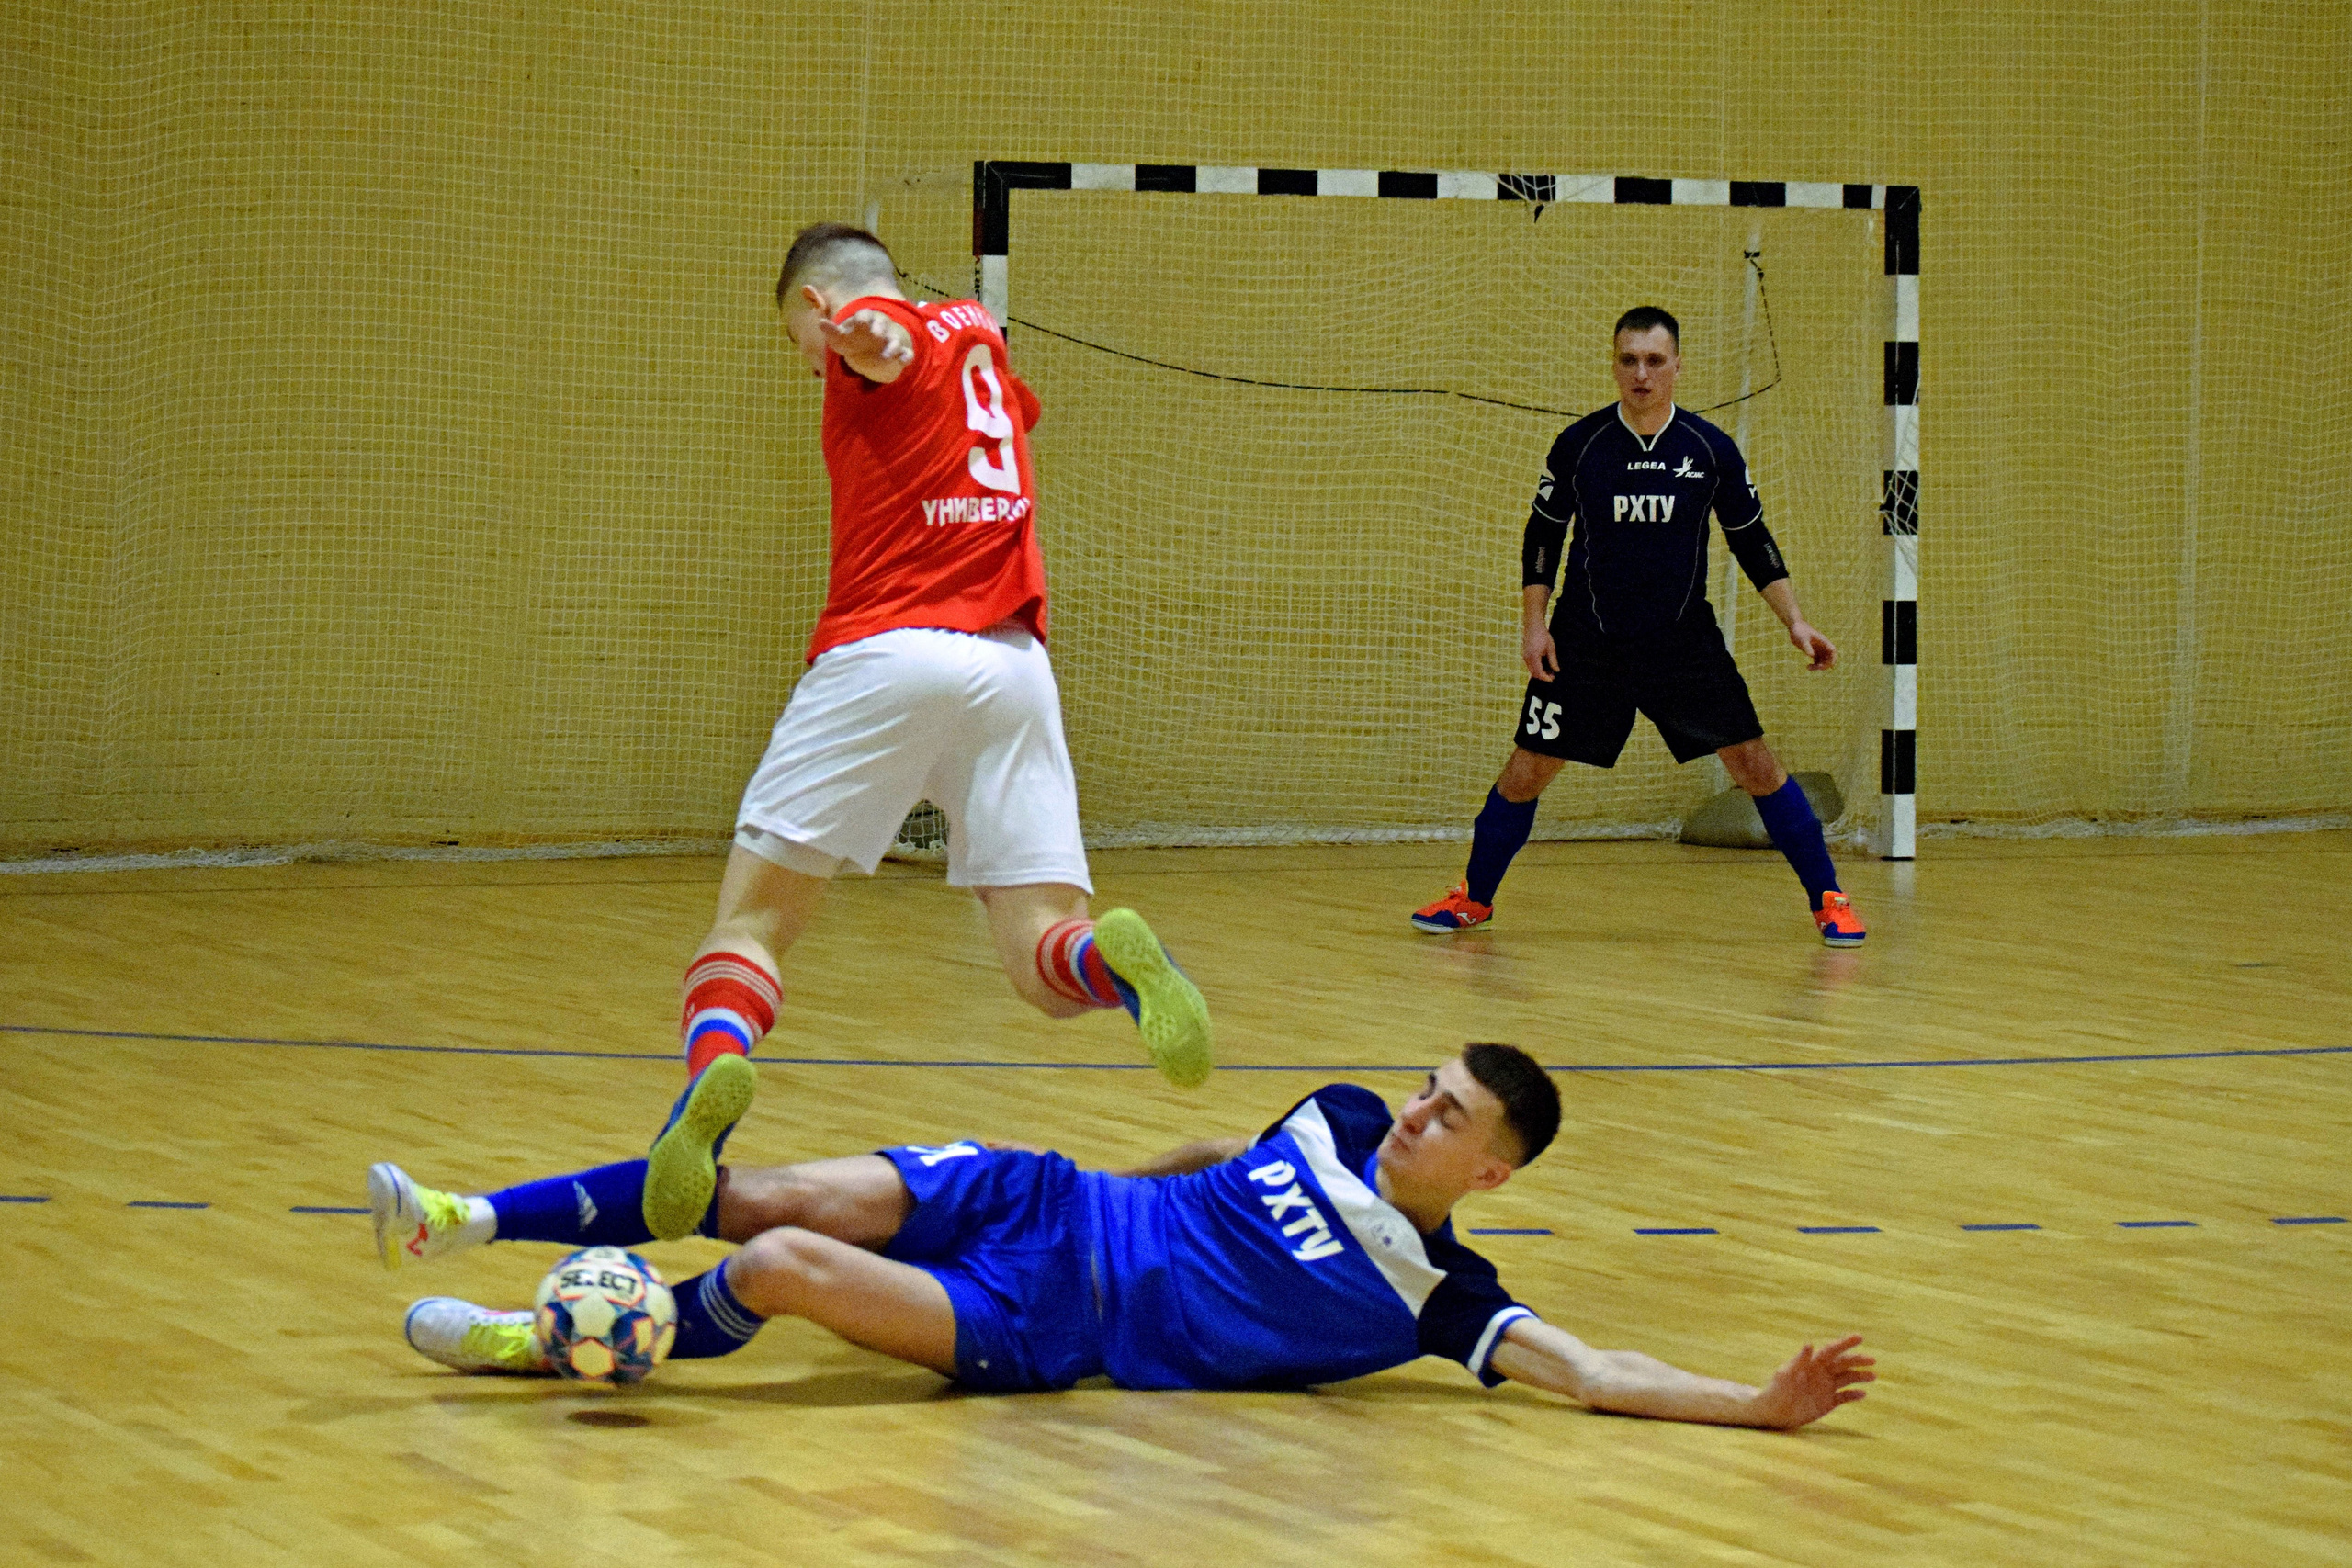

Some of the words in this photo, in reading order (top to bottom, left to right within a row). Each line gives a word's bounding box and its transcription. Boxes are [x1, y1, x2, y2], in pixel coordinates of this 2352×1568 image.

[962, 344, 1021, 495] 9
[1627, 461, 1666, 471] LEGEA
[1613, 495, 1675, 523] РХТУ
[1526, 695, 1562, 740] 55
[1248, 1160, 1344, 1261] РХТУ
